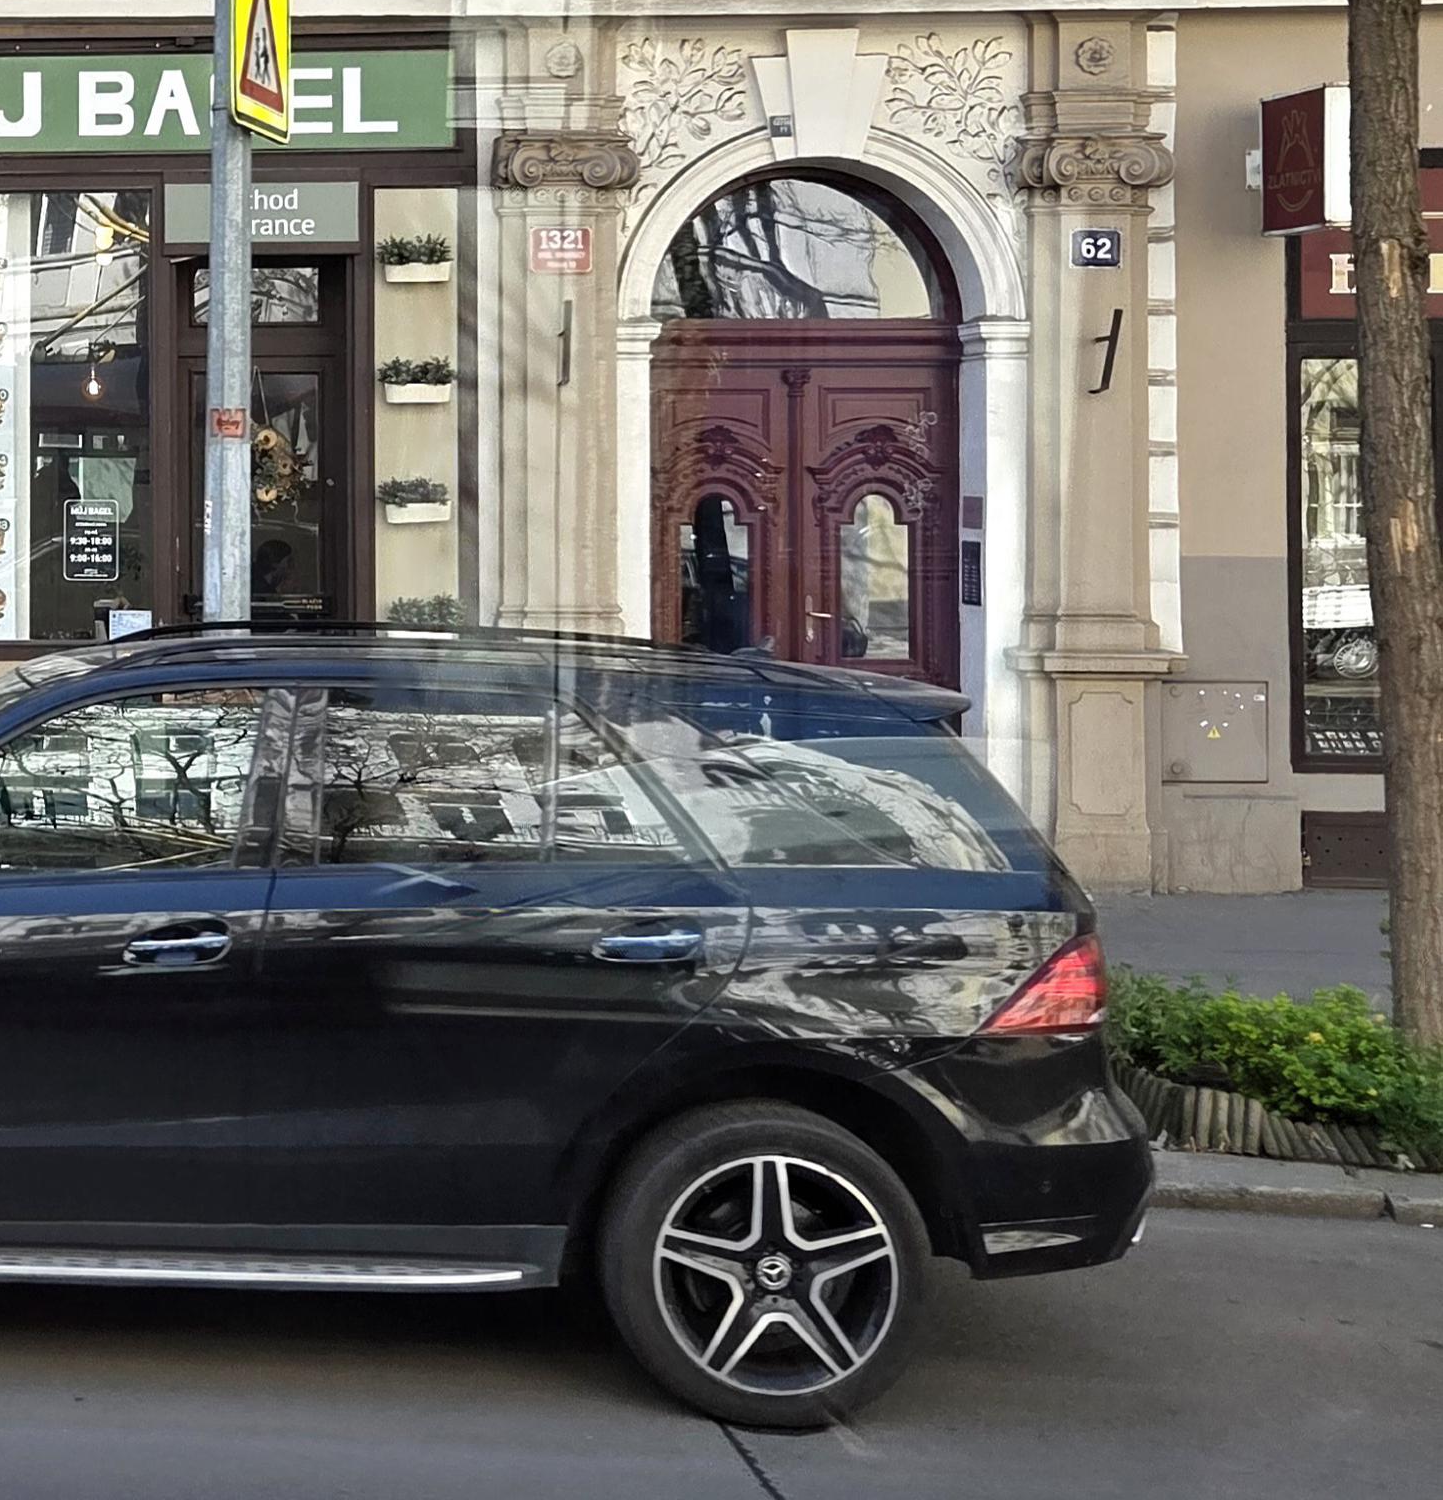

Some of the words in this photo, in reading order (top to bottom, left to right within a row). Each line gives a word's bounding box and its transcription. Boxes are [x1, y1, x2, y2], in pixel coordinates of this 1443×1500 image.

[77, 66, 399, 138] BAEL
[249, 188, 299, 210] hod
[251, 217, 315, 236] rance
[540, 229, 584, 250] 1321
[1081, 237, 1112, 260] 62
